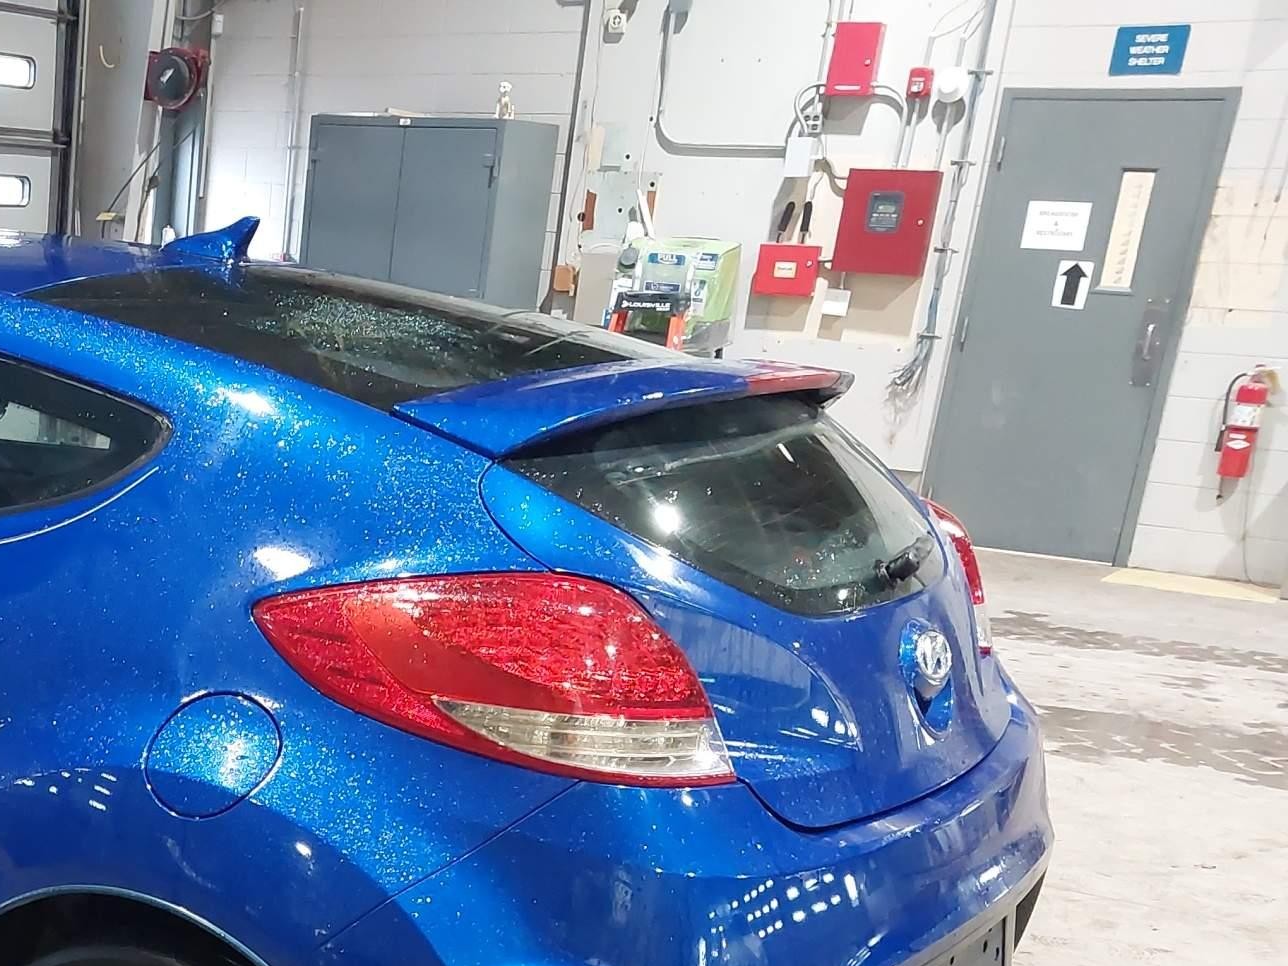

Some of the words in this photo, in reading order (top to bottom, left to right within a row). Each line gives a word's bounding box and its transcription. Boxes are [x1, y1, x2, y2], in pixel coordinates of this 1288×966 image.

[1135, 33, 1169, 43] SEVERE
[1129, 45, 1170, 54] WEATHER
[1128, 56, 1165, 66] SHELTER
